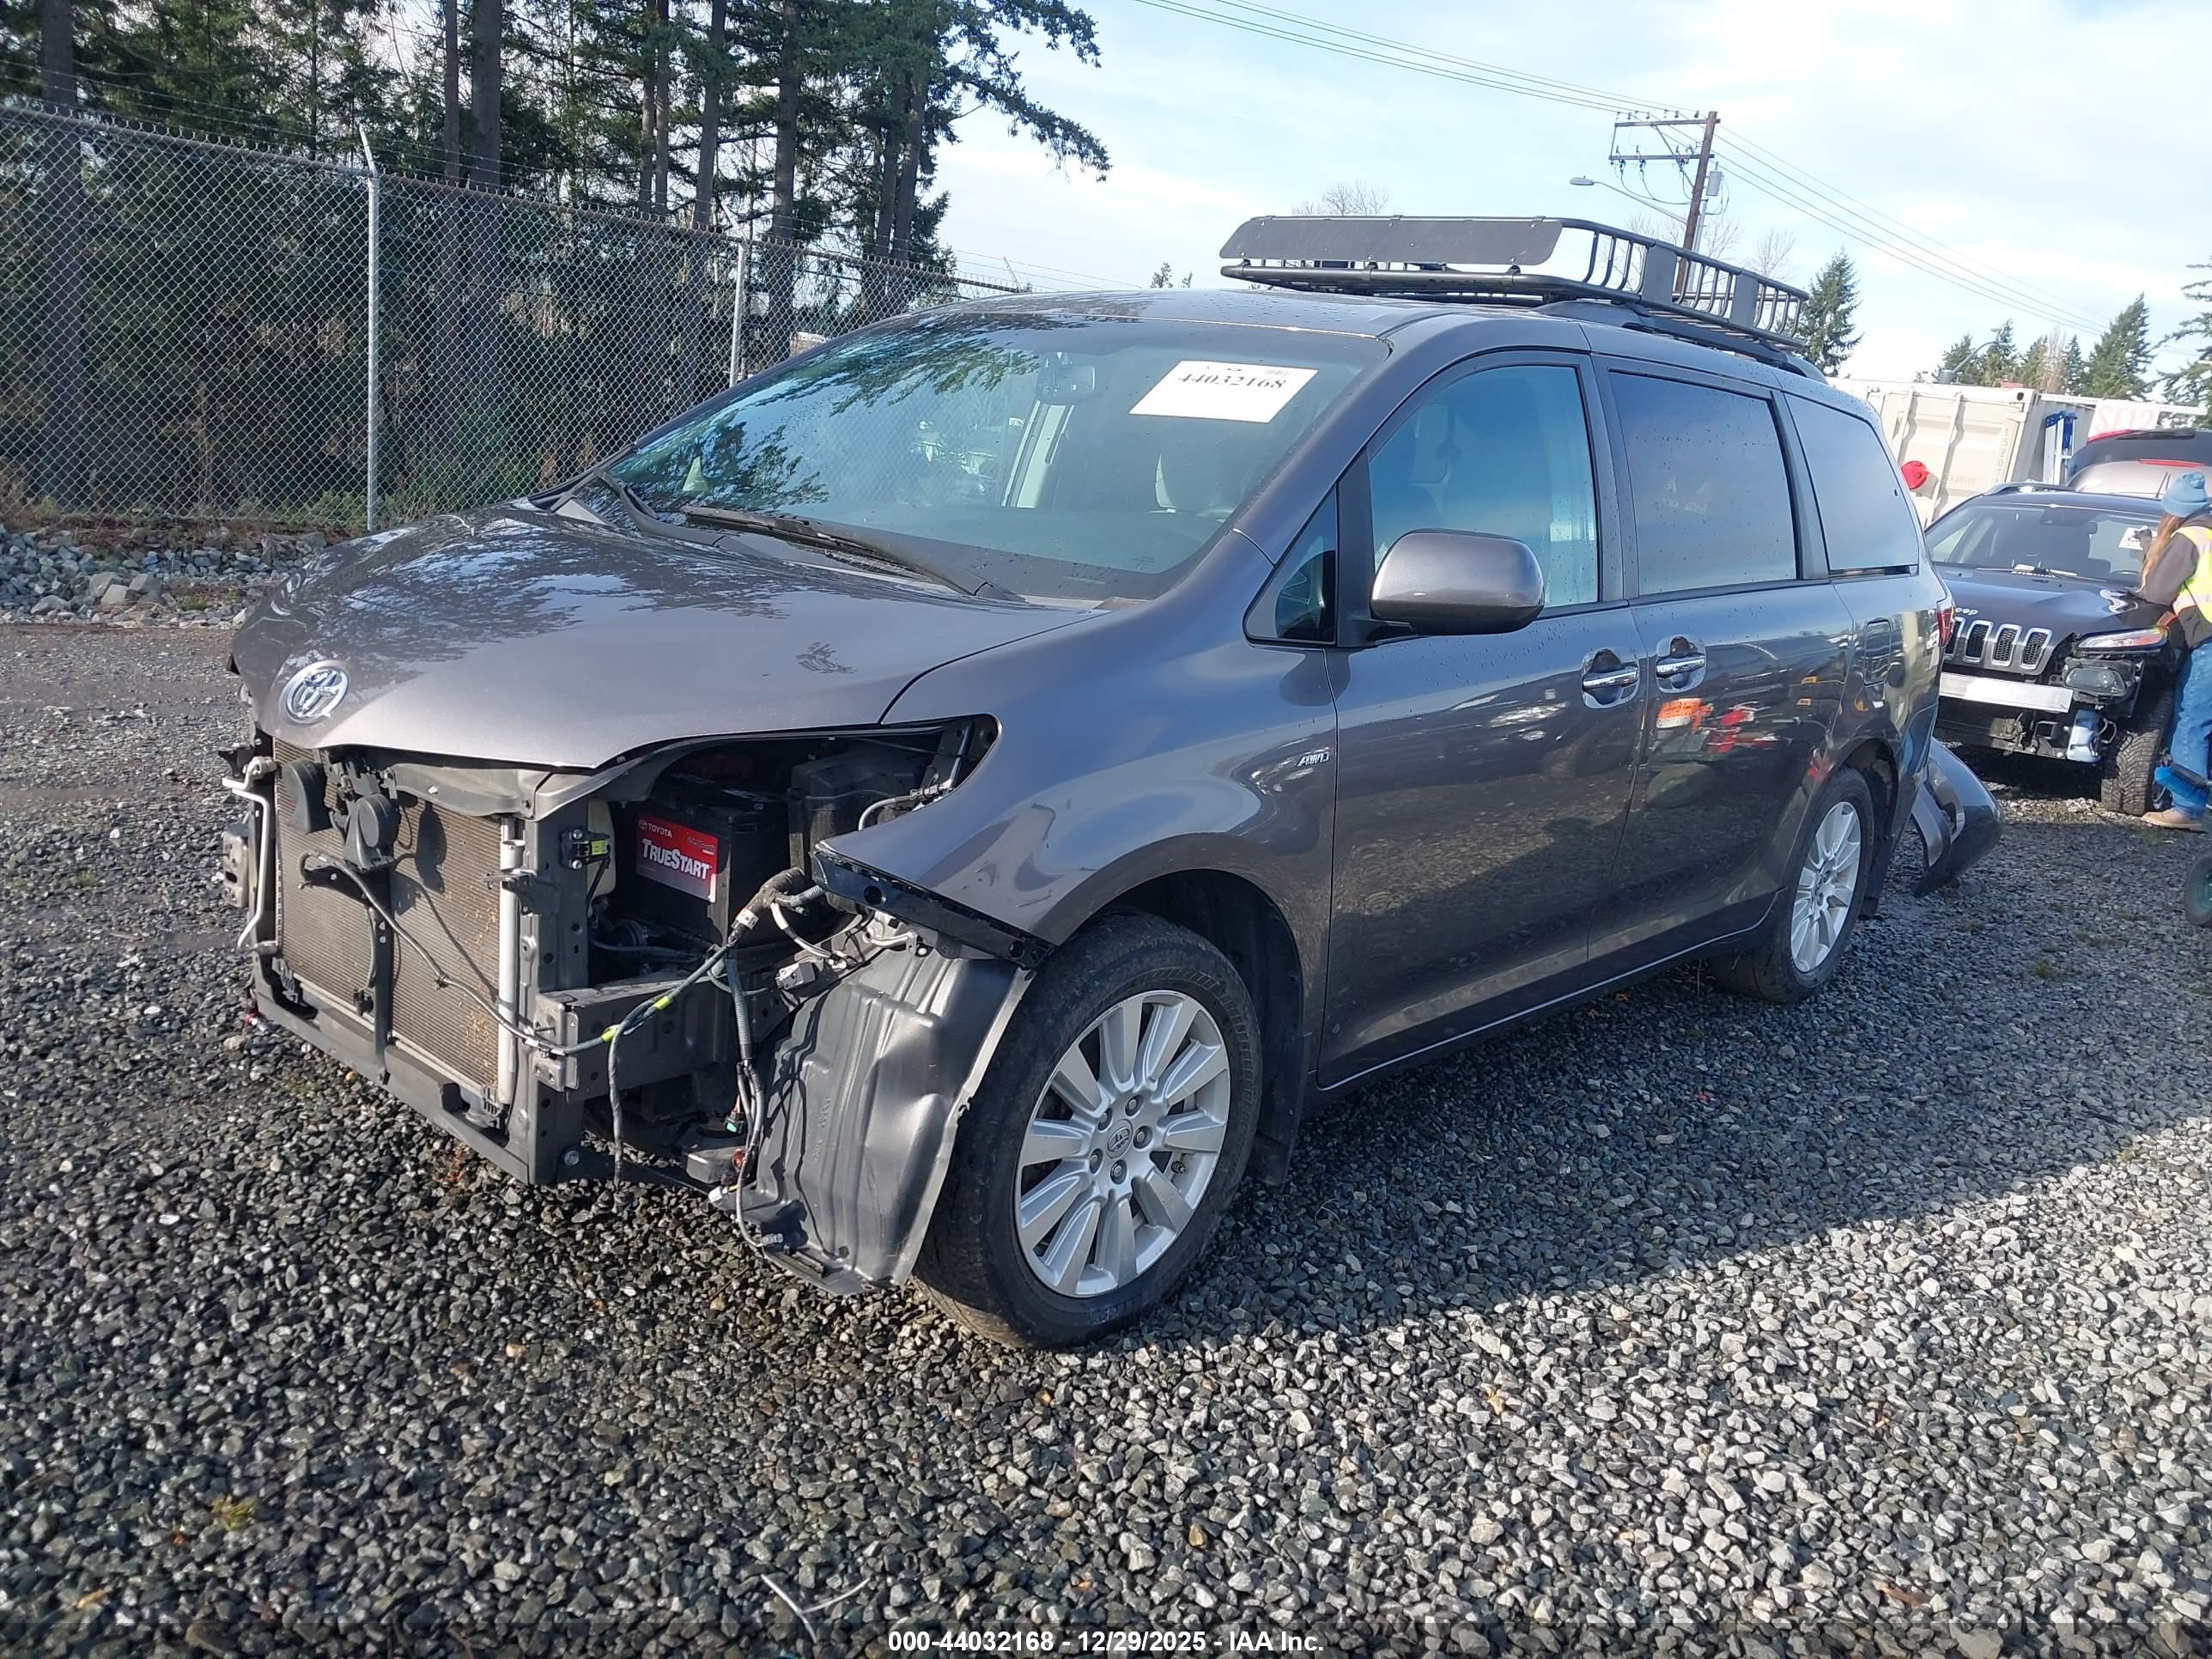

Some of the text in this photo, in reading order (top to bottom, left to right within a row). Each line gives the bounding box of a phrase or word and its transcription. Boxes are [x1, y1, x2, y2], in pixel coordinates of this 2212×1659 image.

[1177, 374, 1287, 388] 44032168
[1955, 606, 1979, 616] eep
[1297, 751, 1329, 767] AWD
[648, 823, 673, 838] TOYOTA
